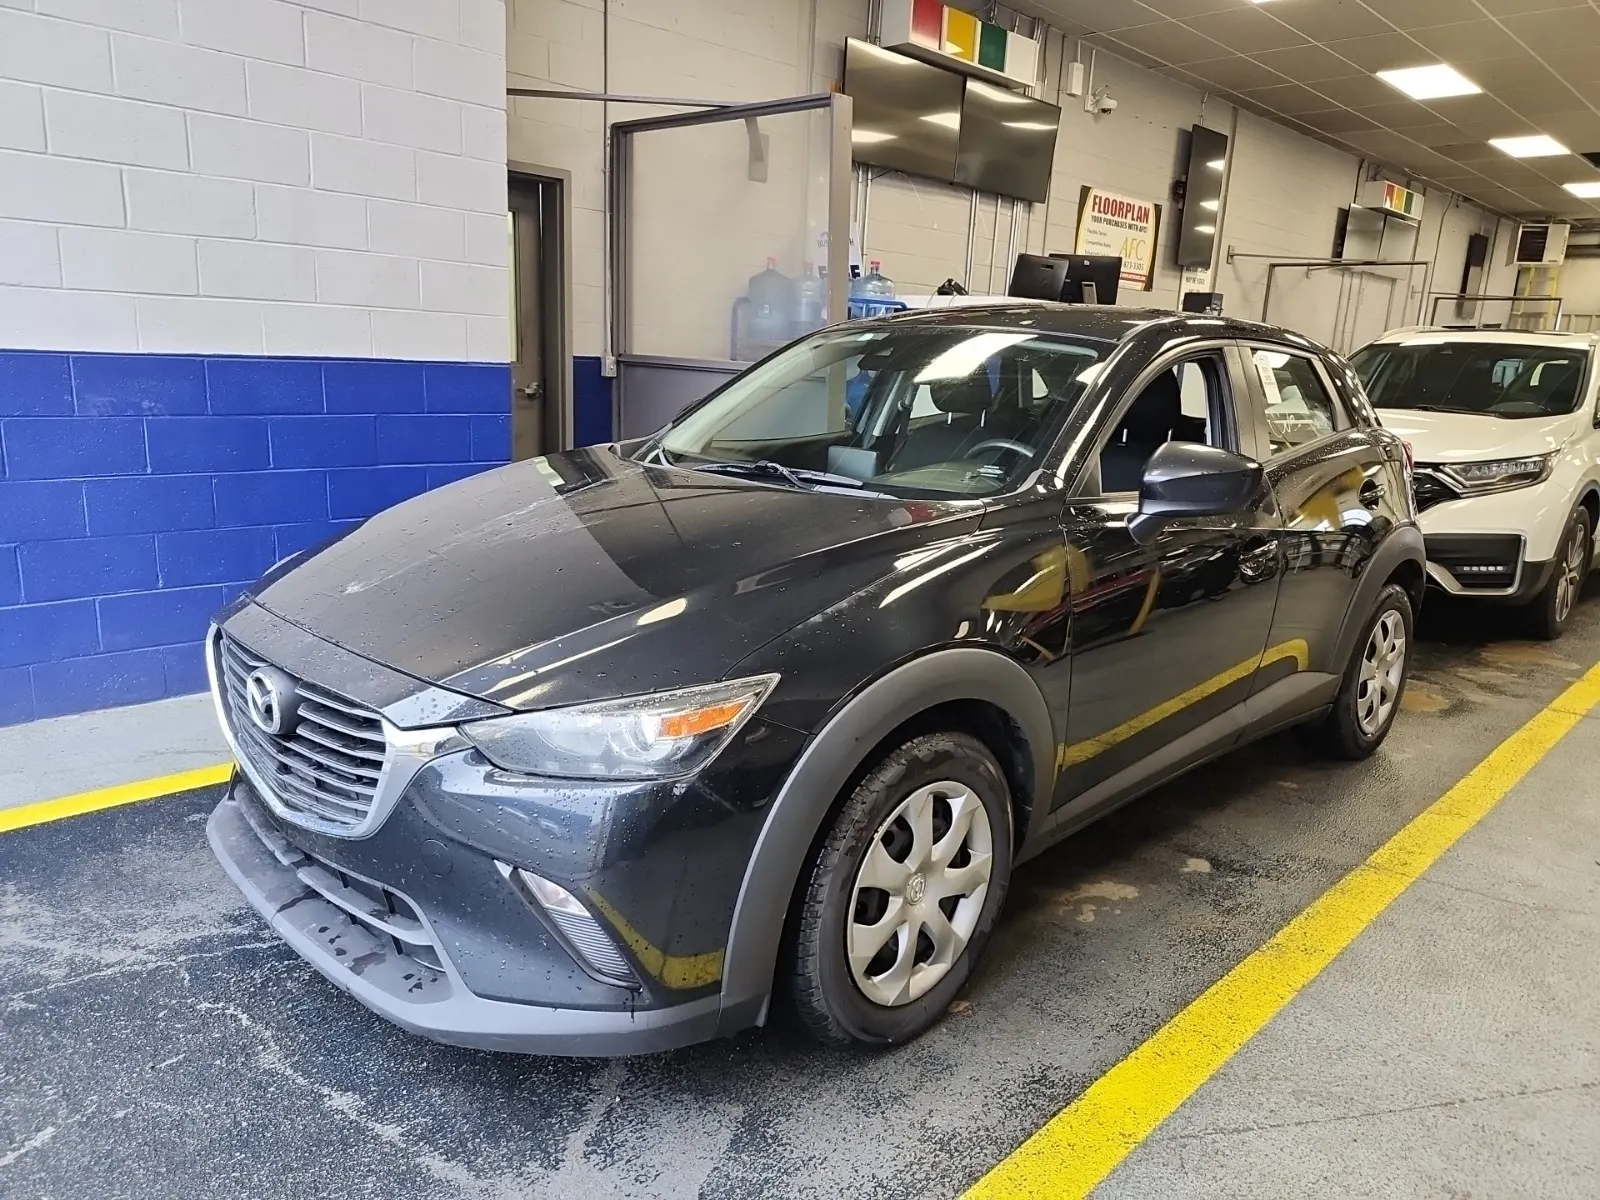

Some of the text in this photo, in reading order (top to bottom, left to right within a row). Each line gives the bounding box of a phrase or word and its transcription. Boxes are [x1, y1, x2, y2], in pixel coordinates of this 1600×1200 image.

[1092, 194, 1150, 224] FLOORPLAN
[1091, 215, 1102, 224] YOUR
[1103, 217, 1127, 230] PURCHASES
[1128, 222, 1139, 232] WITH
[1119, 237, 1146, 261] AFC
[1122, 260, 1144, 271] -873-3305
